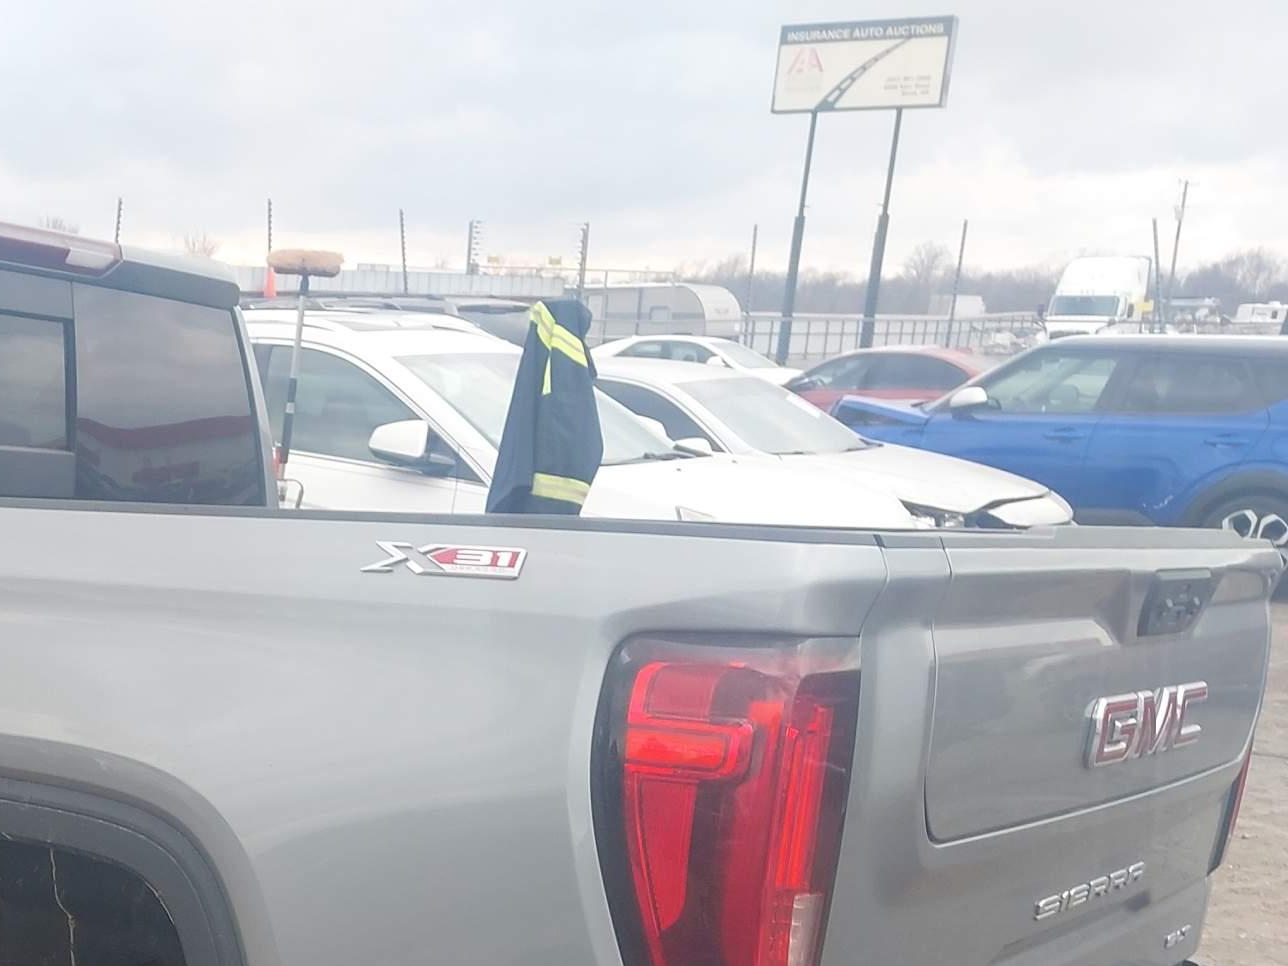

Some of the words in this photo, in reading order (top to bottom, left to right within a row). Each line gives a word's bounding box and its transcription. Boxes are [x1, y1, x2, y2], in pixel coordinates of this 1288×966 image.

[787, 28, 850, 42] INSURANCE
[853, 26, 884, 39] AUTO
[886, 23, 944, 37] AUCTIONS
[360, 540, 527, 579] X31
[1086, 681, 1208, 768] GMC
[1033, 861, 1144, 921] SIERRA
